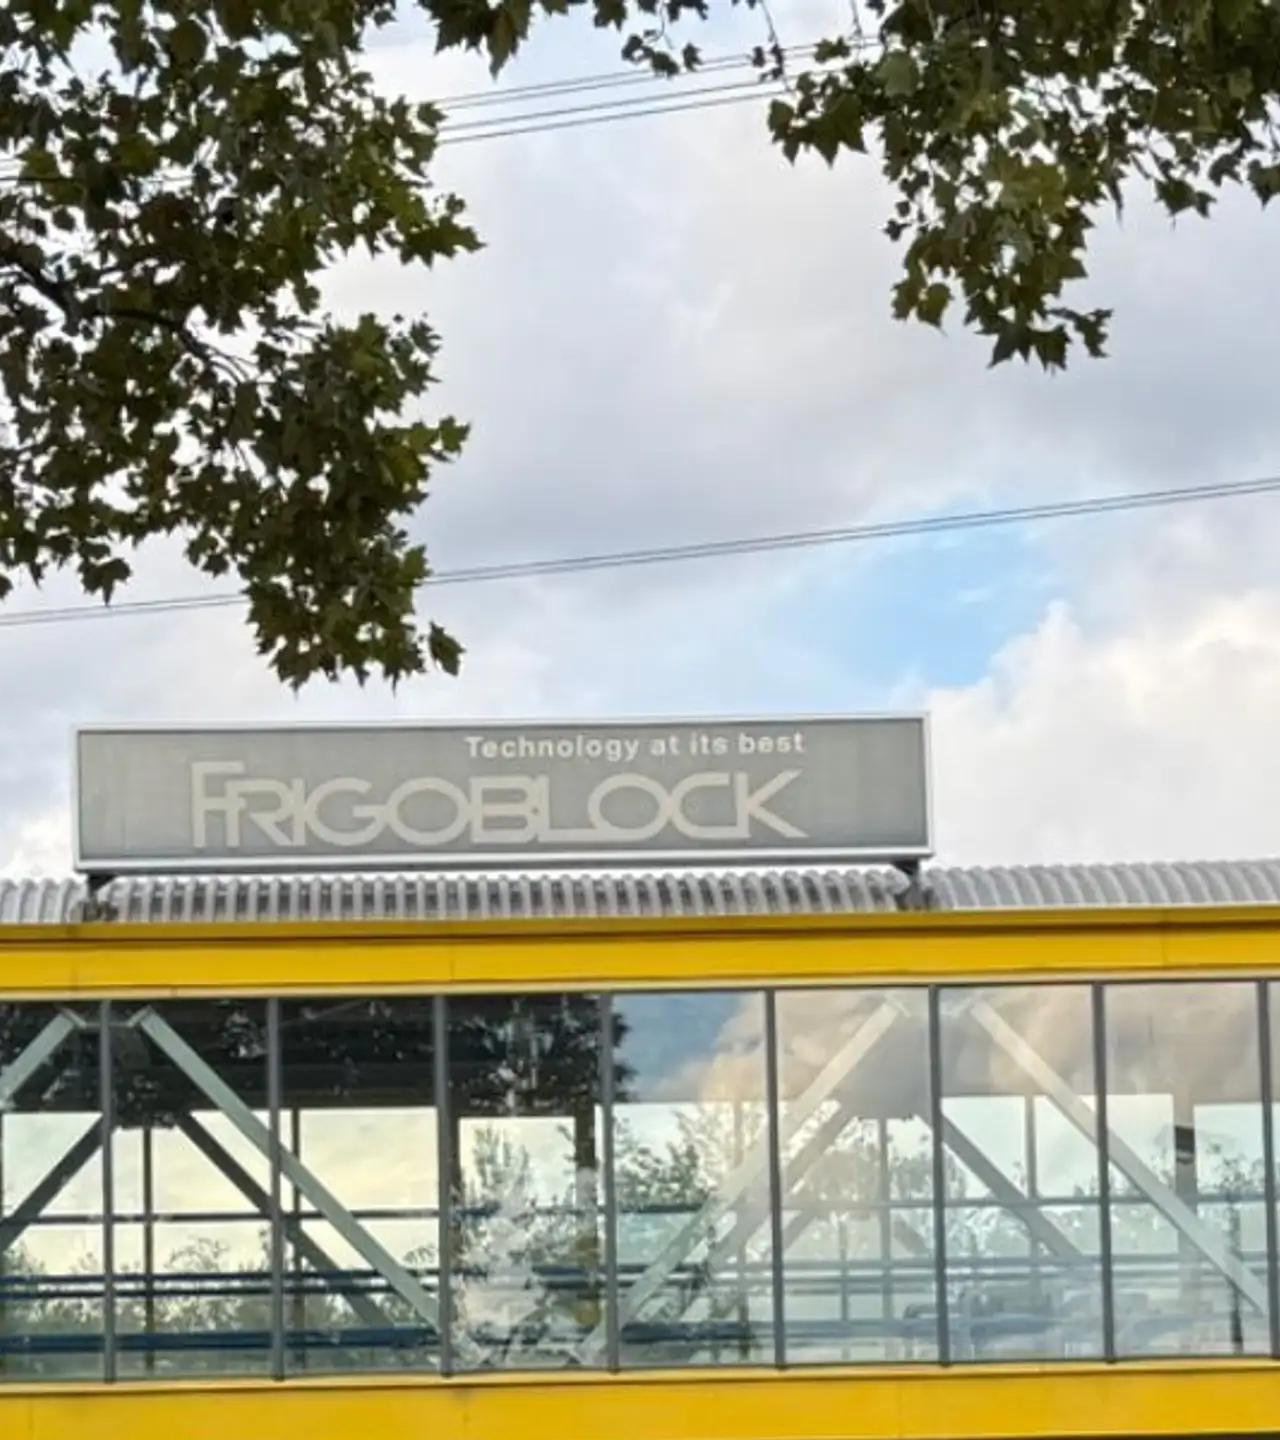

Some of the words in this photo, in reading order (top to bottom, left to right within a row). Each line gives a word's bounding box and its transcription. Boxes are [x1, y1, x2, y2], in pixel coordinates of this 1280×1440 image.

[463, 734, 640, 763] Technology
[650, 732, 680, 757] at
[690, 731, 729, 756] its
[738, 731, 806, 755] best
[190, 760, 810, 848] FRIGOBLOCK
